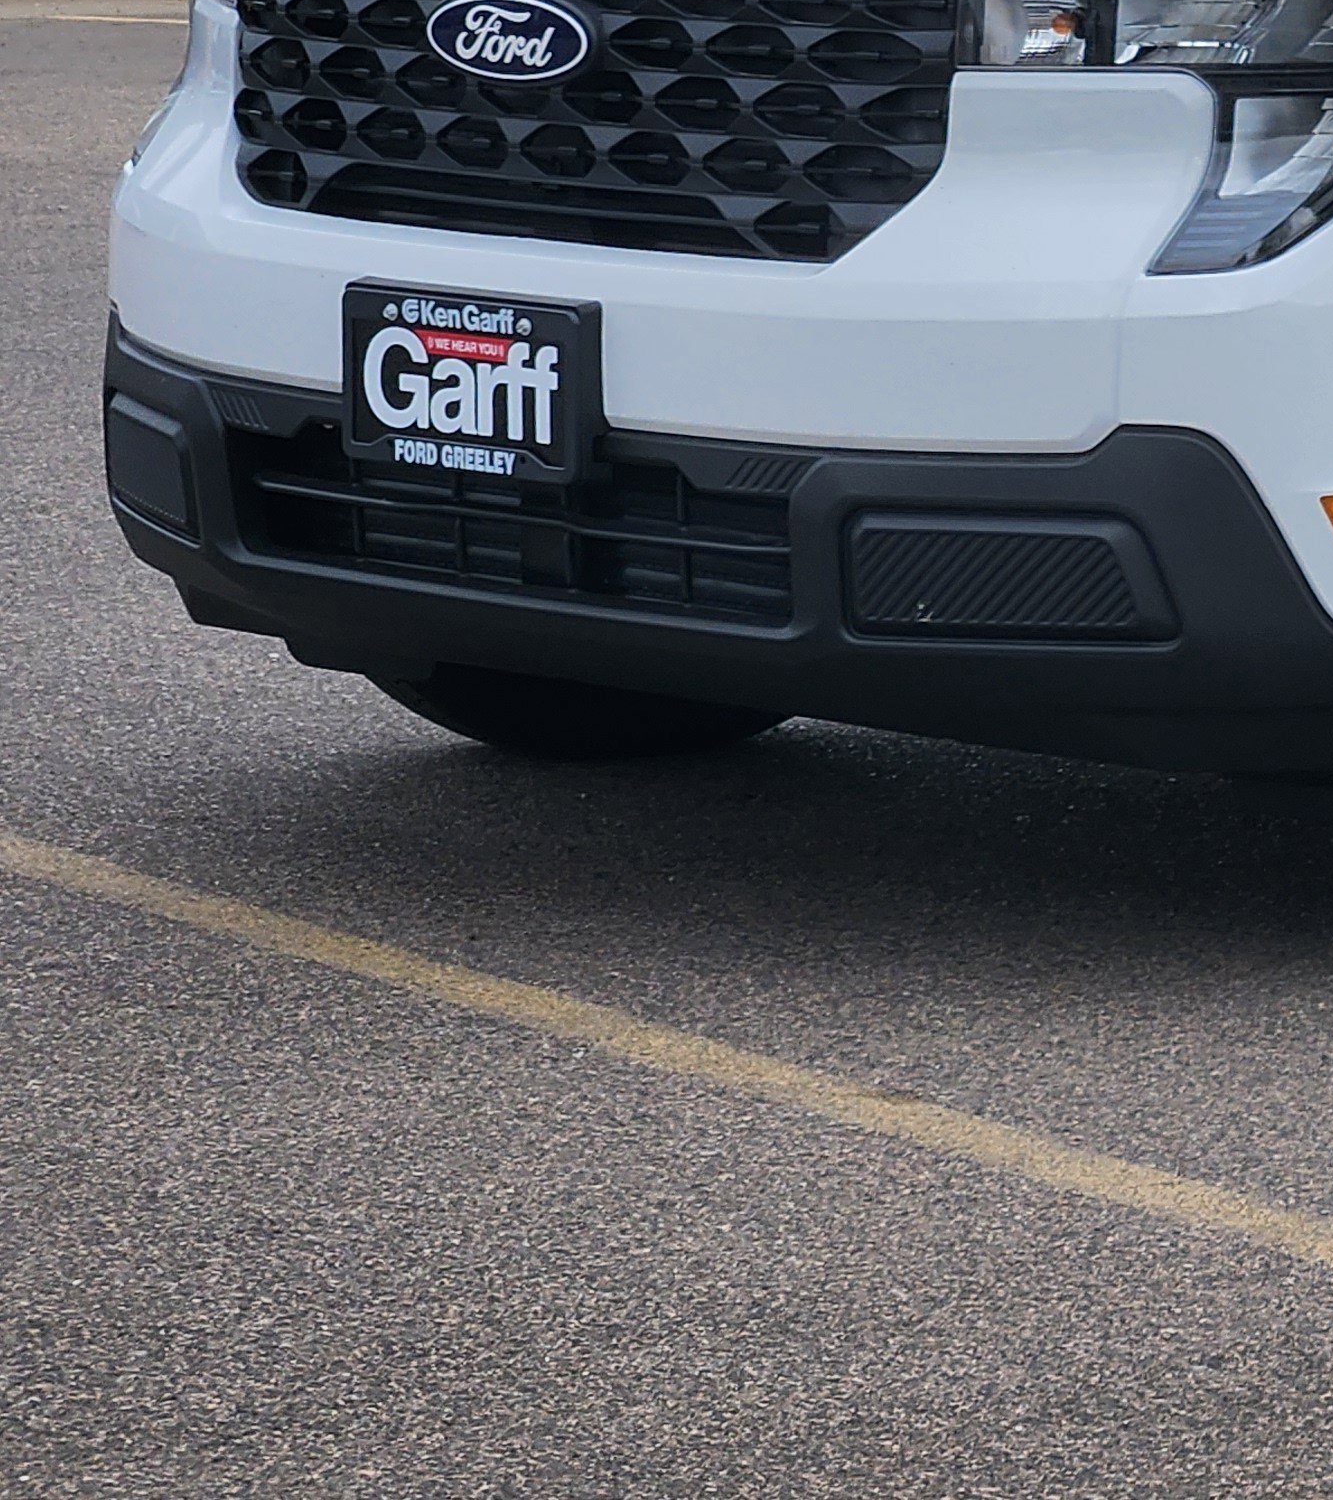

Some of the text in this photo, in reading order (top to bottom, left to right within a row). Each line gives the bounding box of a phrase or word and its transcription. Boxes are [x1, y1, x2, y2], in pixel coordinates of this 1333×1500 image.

[455, 4, 556, 67] Ford
[421, 300, 515, 334] Ken Garff
[435, 338, 498, 357] WE HEAR YOU
[364, 326, 559, 445] Garff
[394, 439, 517, 476] FORD GREELEY
